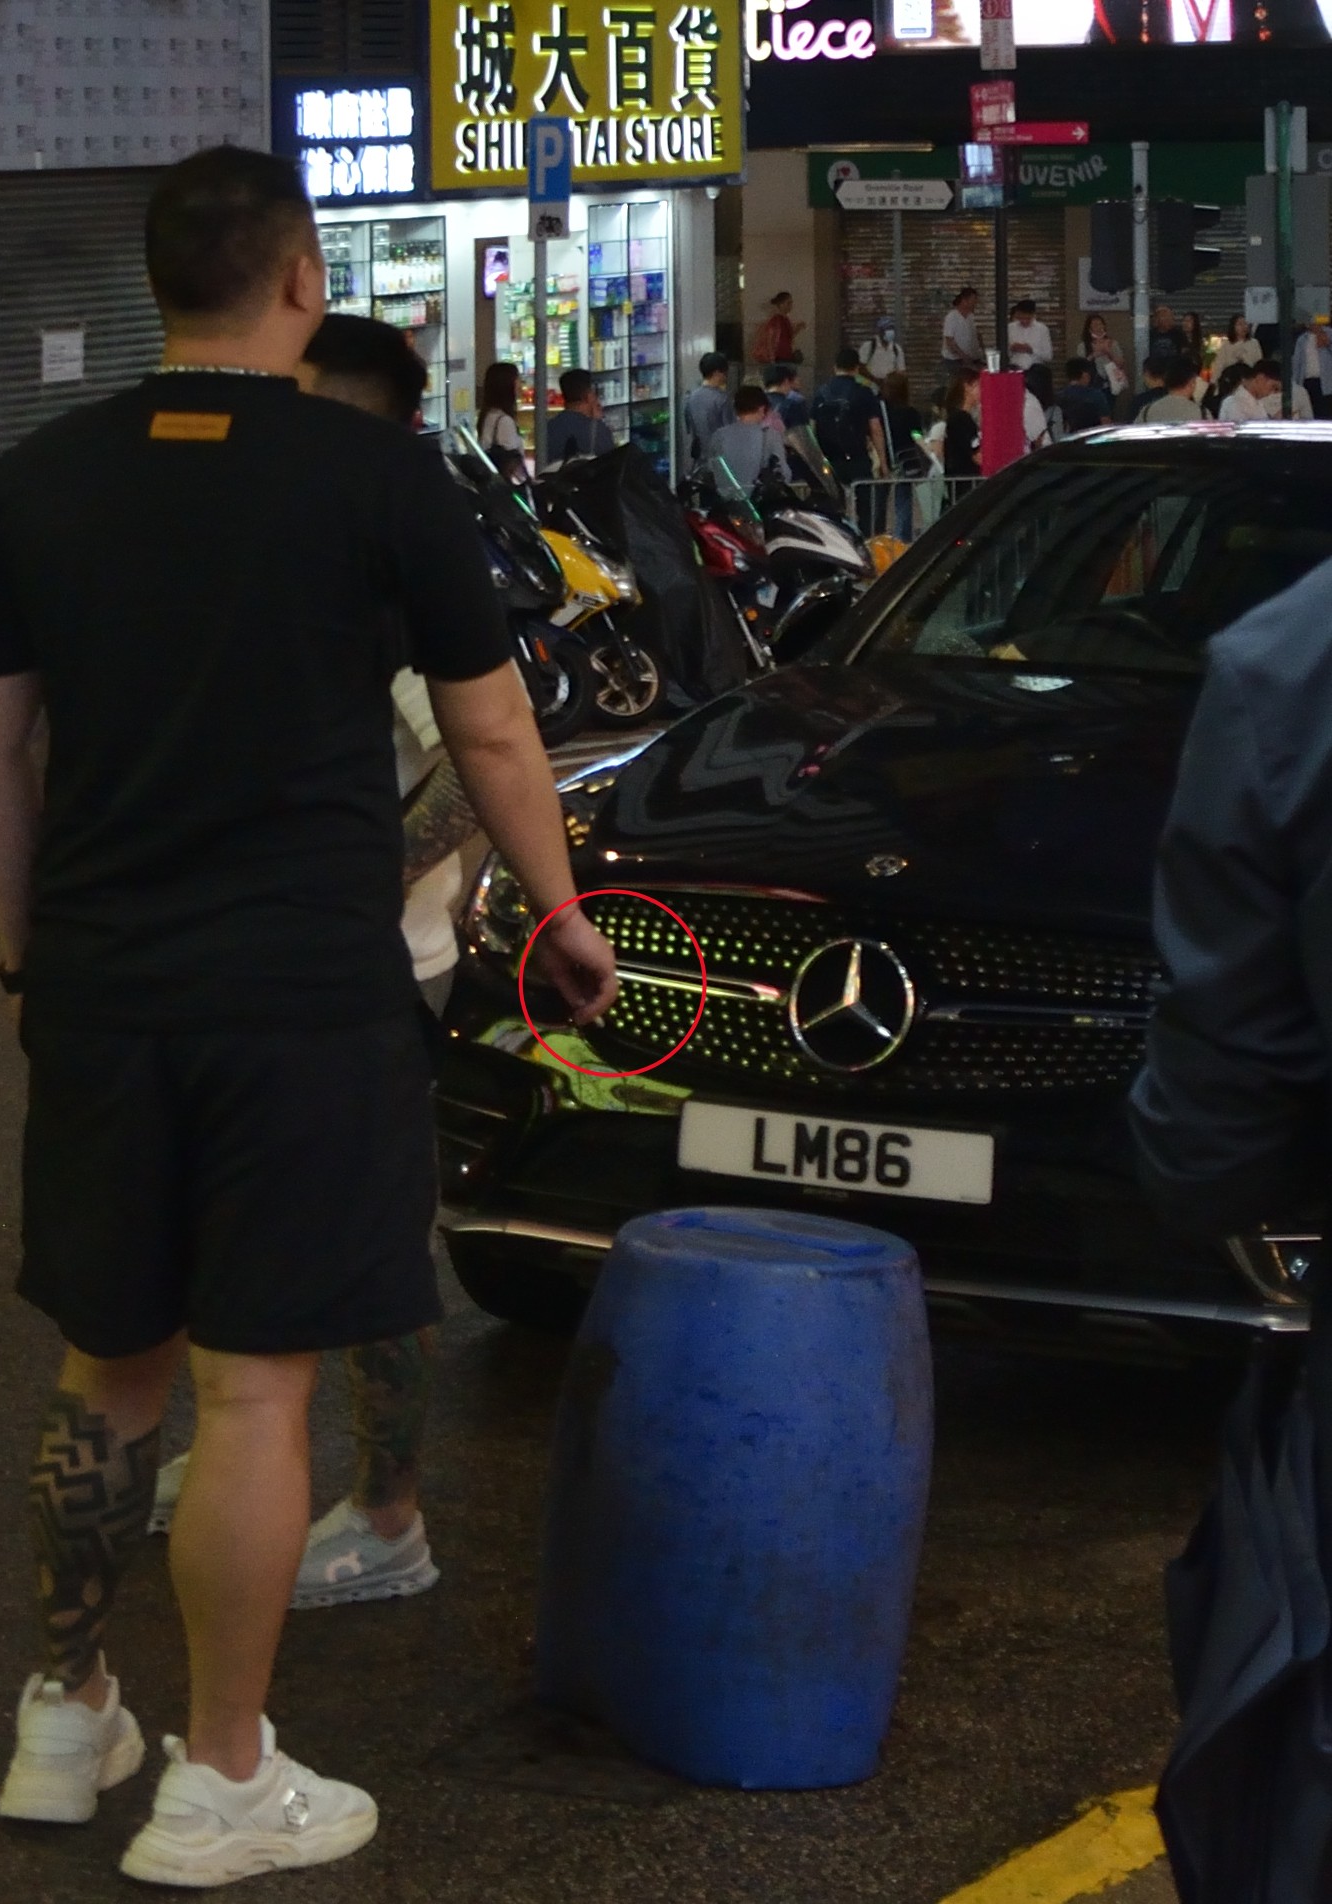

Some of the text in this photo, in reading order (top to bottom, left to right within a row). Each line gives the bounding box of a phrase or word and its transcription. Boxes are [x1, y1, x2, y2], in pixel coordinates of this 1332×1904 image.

[455, 112, 723, 173] SHI TAI STORE
[537, 126, 564, 195] P
[1019, 154, 1108, 188] UVENIR
[753, 1116, 912, 1188] LM86
